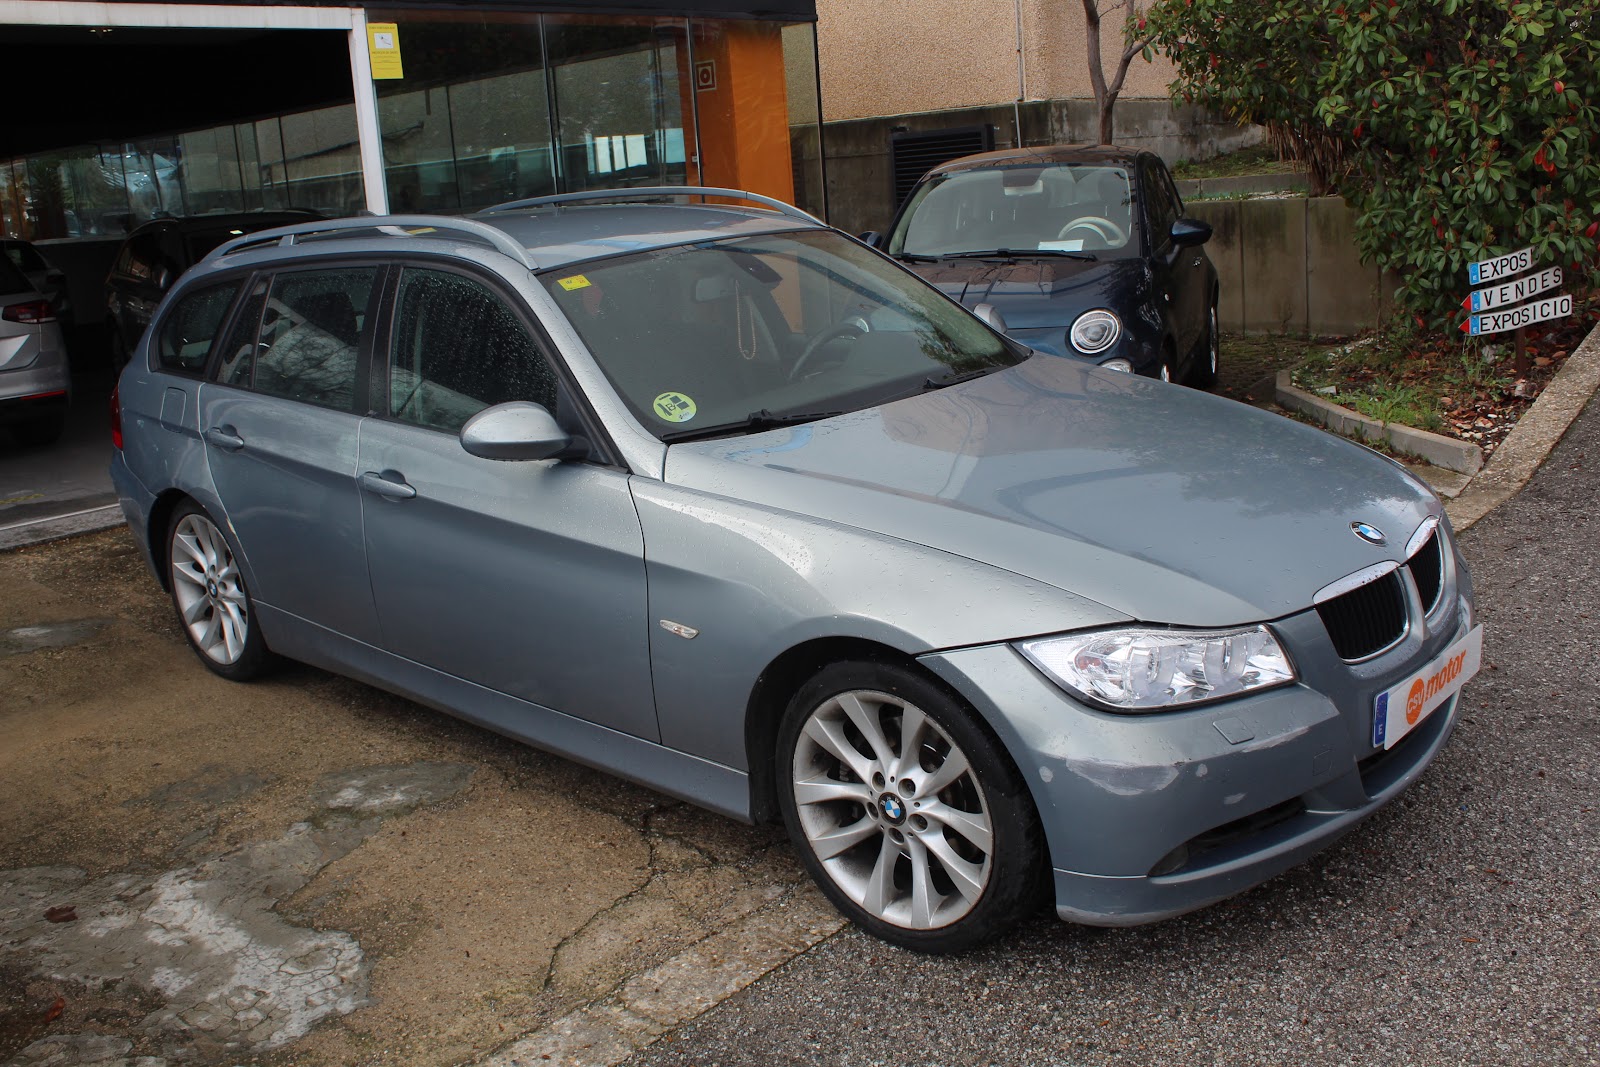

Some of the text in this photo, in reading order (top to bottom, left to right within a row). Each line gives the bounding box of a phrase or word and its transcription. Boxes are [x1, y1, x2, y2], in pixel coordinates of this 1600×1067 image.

[1484, 267, 1561, 307] VENDES
[1480, 298, 1570, 332] EXPOSICIO
[1424, 649, 1467, 702] motor
[1378, 723, 1383, 736] E
